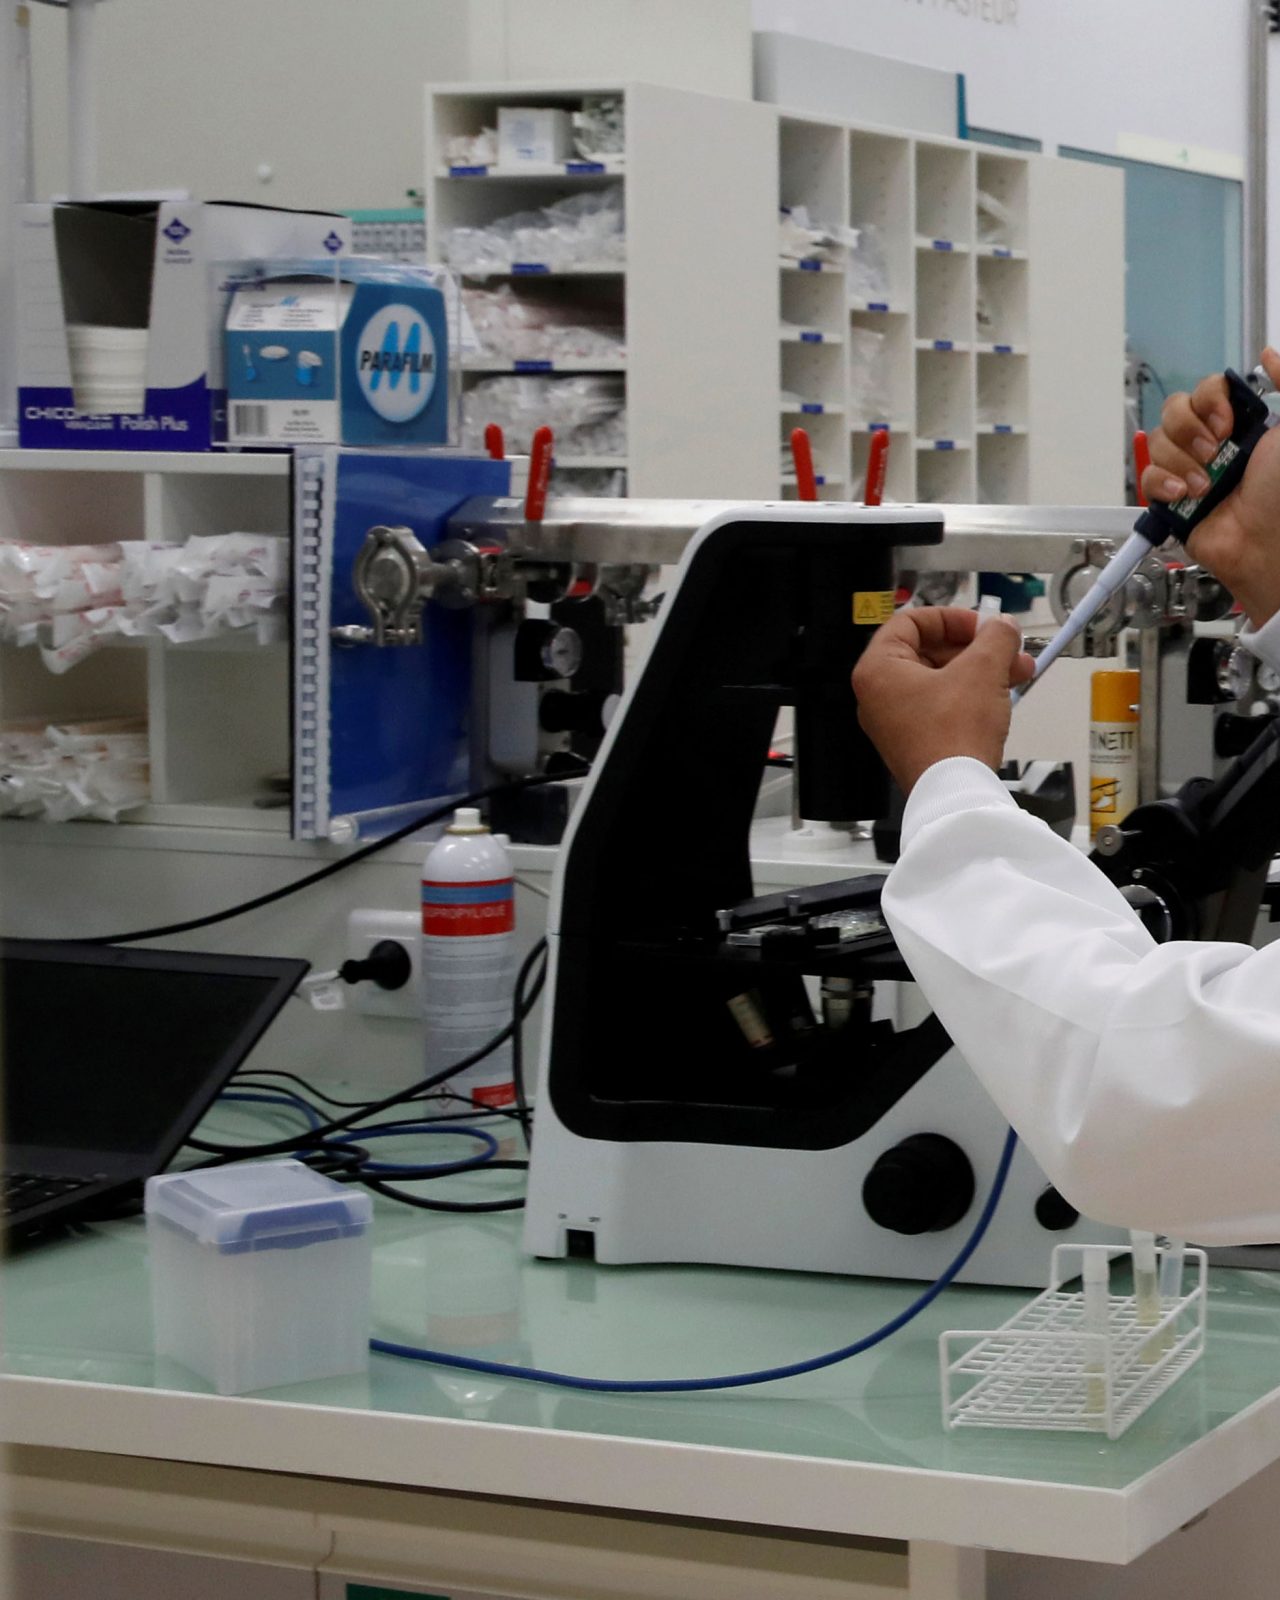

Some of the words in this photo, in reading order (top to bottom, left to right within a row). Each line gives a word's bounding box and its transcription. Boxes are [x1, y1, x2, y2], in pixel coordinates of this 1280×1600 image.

[360, 350, 433, 373] PARAFILM
[25, 407, 113, 421] CHICO
[120, 414, 159, 432] Polish
[160, 415, 189, 432] Plus
